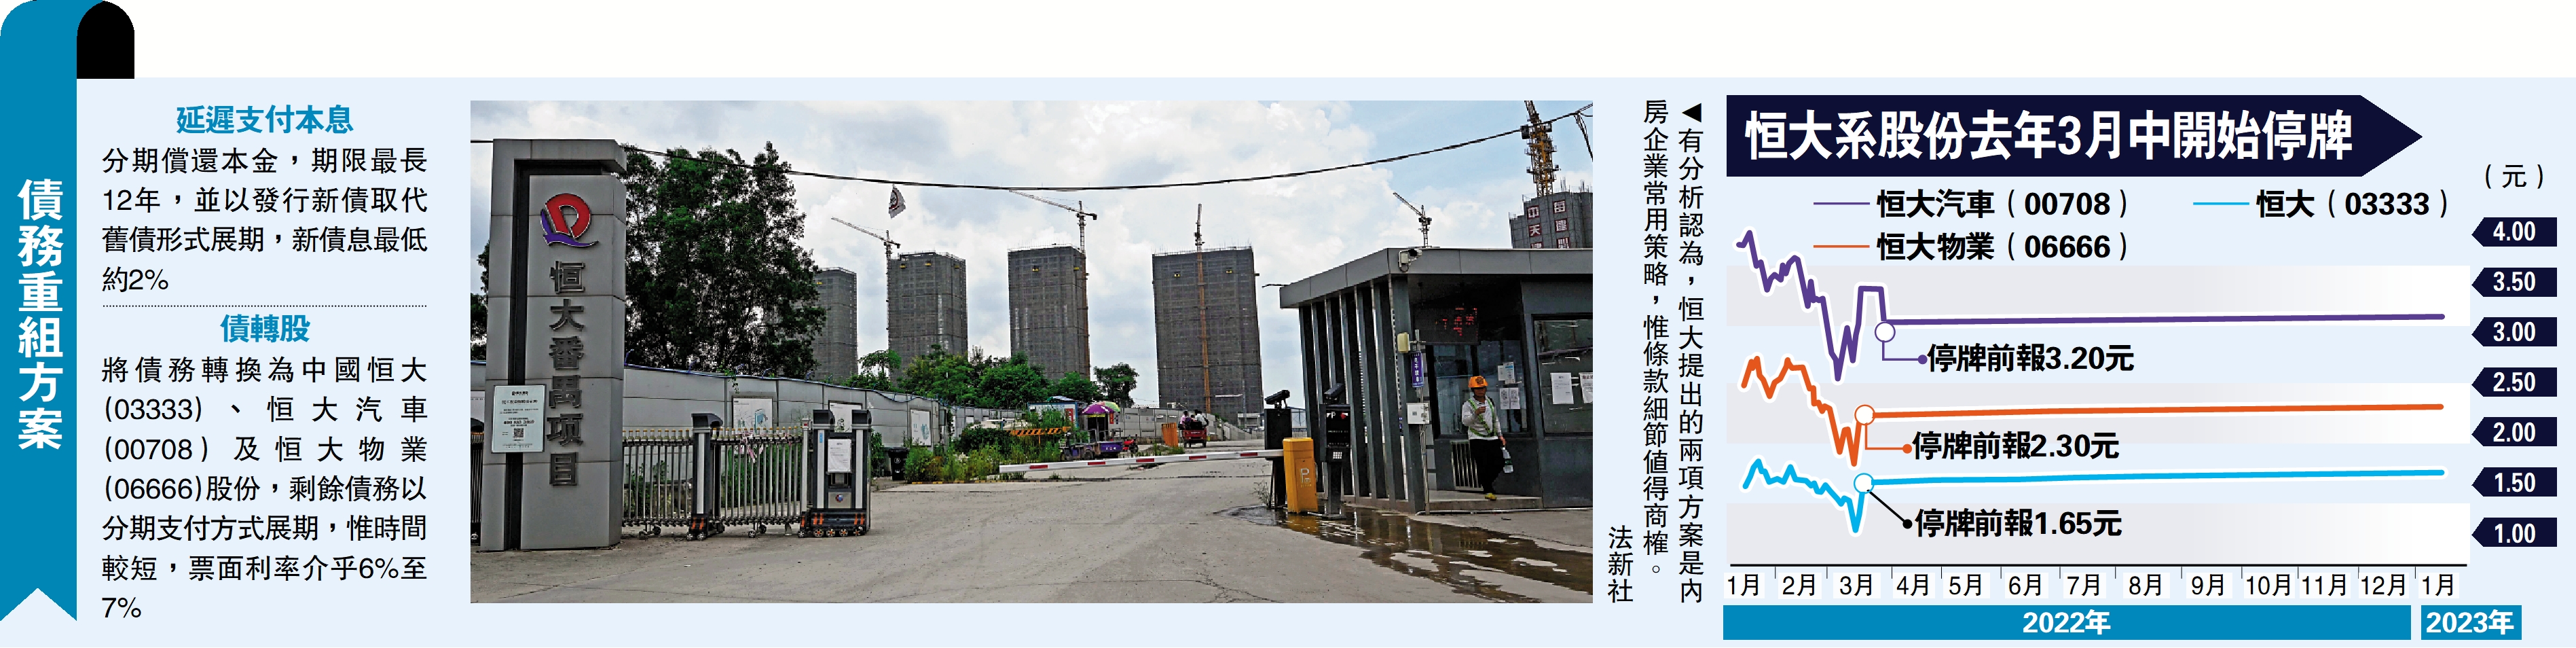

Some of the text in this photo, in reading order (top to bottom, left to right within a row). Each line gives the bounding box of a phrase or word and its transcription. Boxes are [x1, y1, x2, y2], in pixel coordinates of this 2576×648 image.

[547, 260, 585, 486] 恒大番禺项目
